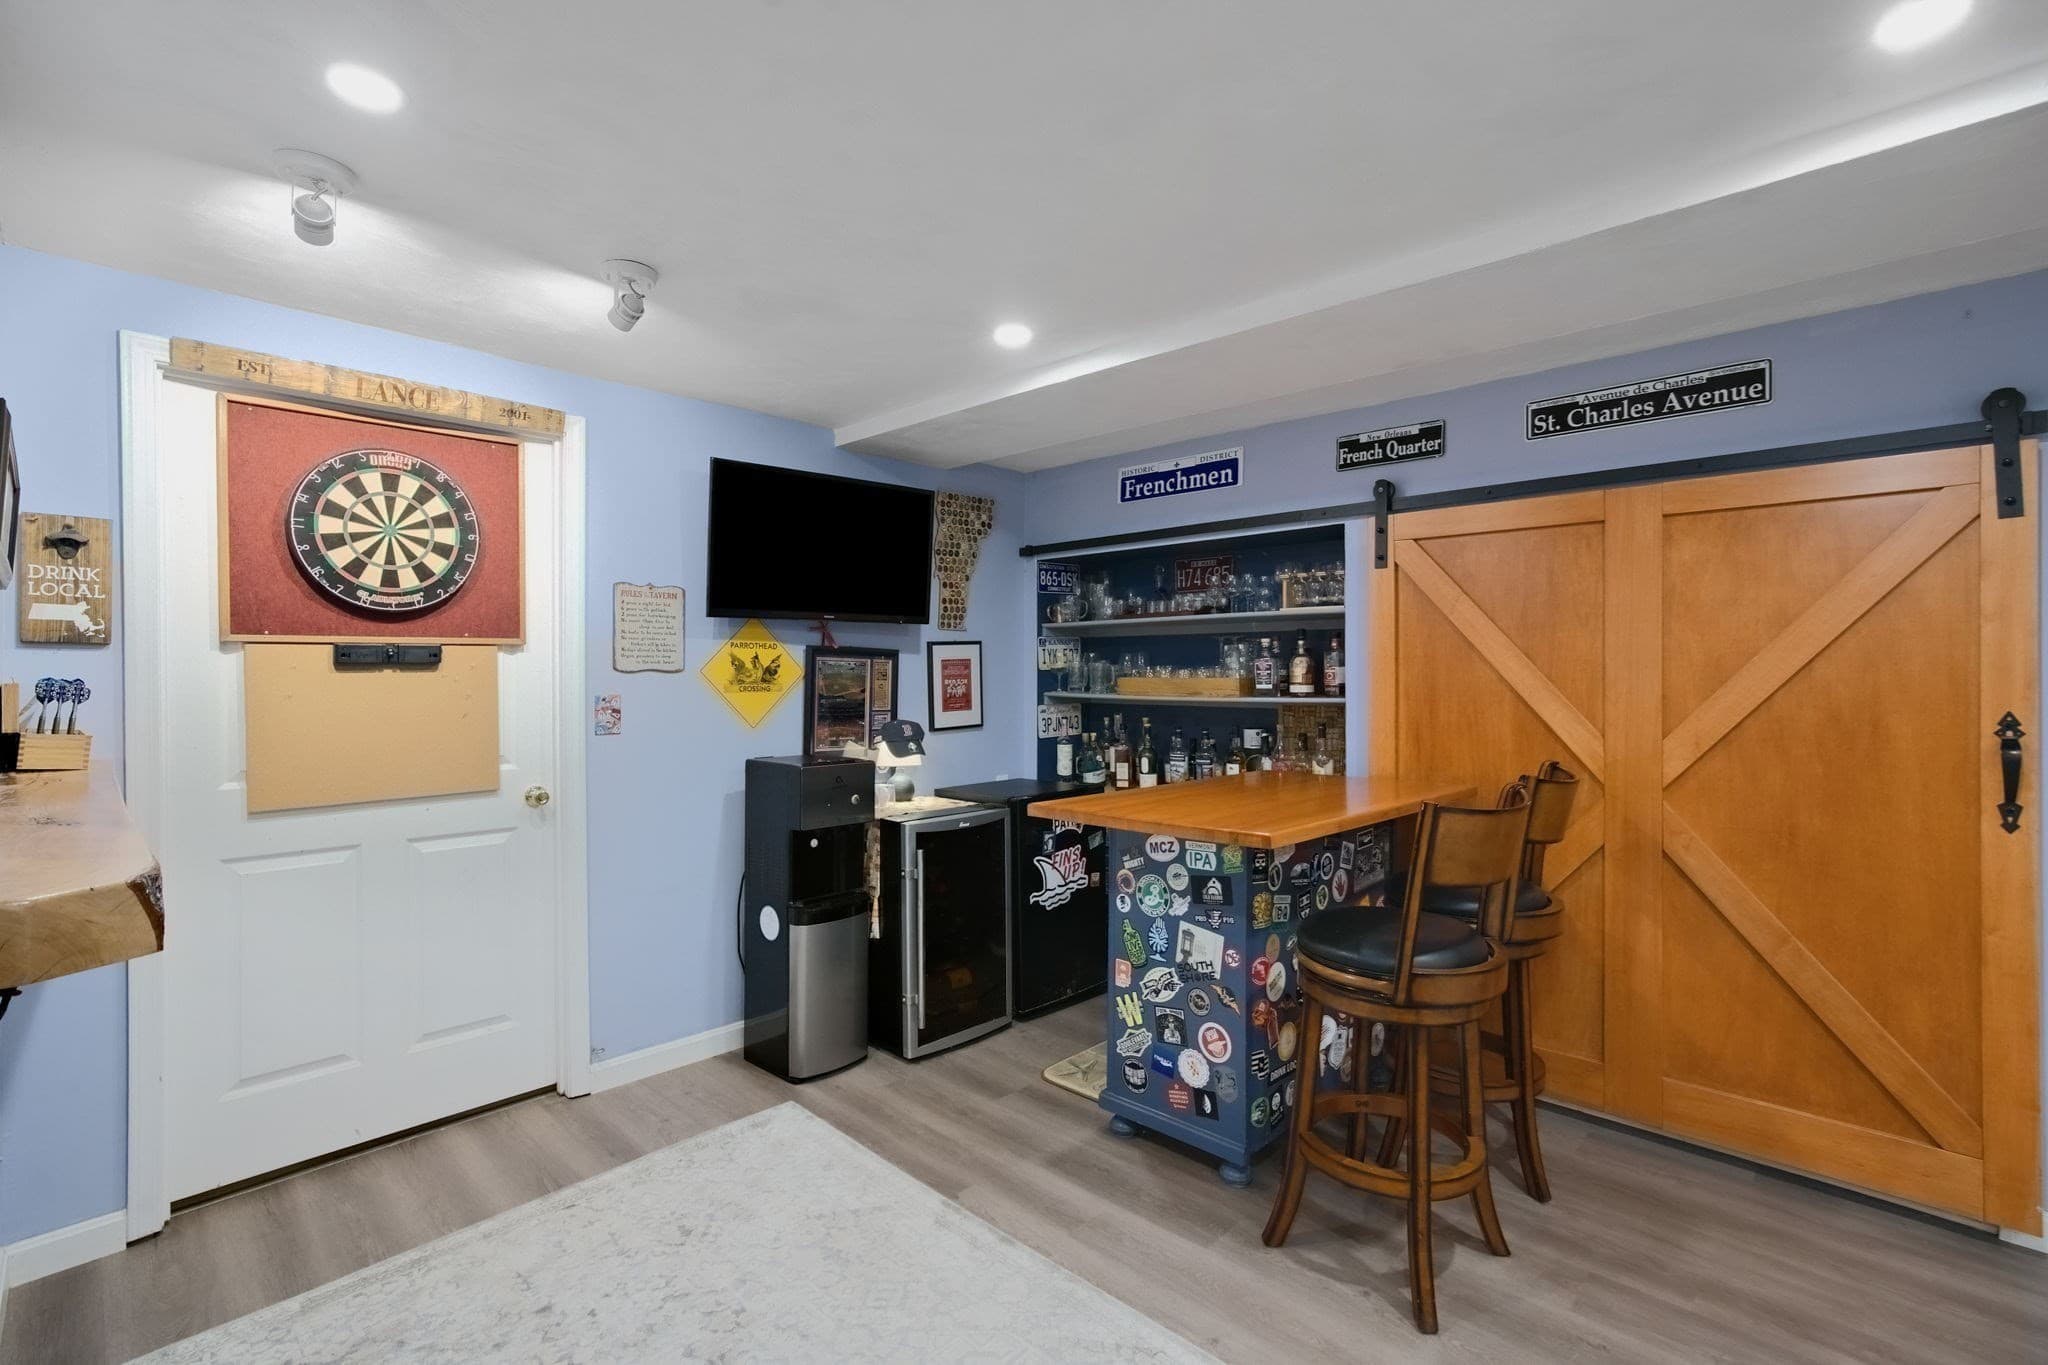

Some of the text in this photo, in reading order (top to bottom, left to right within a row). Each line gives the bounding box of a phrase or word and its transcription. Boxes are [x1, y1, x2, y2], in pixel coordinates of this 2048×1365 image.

[356, 376, 440, 409] LANCE
[1580, 388, 1630, 404] Avenue
[1633, 385, 1649, 395] de
[1652, 374, 1706, 391] Charles
[1533, 414, 1561, 434] St.
[1567, 399, 1655, 428] Charles
[1662, 382, 1763, 413] Avenue
[1384, 429, 1412, 439] Orleans
[1339, 438, 1441, 465] French Quarter
[1121, 450, 1239, 477] HISTORIC DISTRICT
[1124, 467, 1234, 499] Frenchmen
[27, 563, 101, 582] DRINK
[1040, 570, 1078, 587] 865-DSK
[27, 581, 106, 599] LOCAL
[648, 591, 678, 600] TAVERN
[730, 641, 778, 650] PARROTHEAD
[738, 684, 772, 693] CROSSING
[1149, 841, 1176, 854] MCZ
[1188, 842, 1214, 851] VERMONT
[1052, 846, 1081, 867] FINS
[1189, 851, 1213, 870] IPA
[1064, 859, 1086, 881] UP!
[1177, 960, 1215, 973] SOUTH
